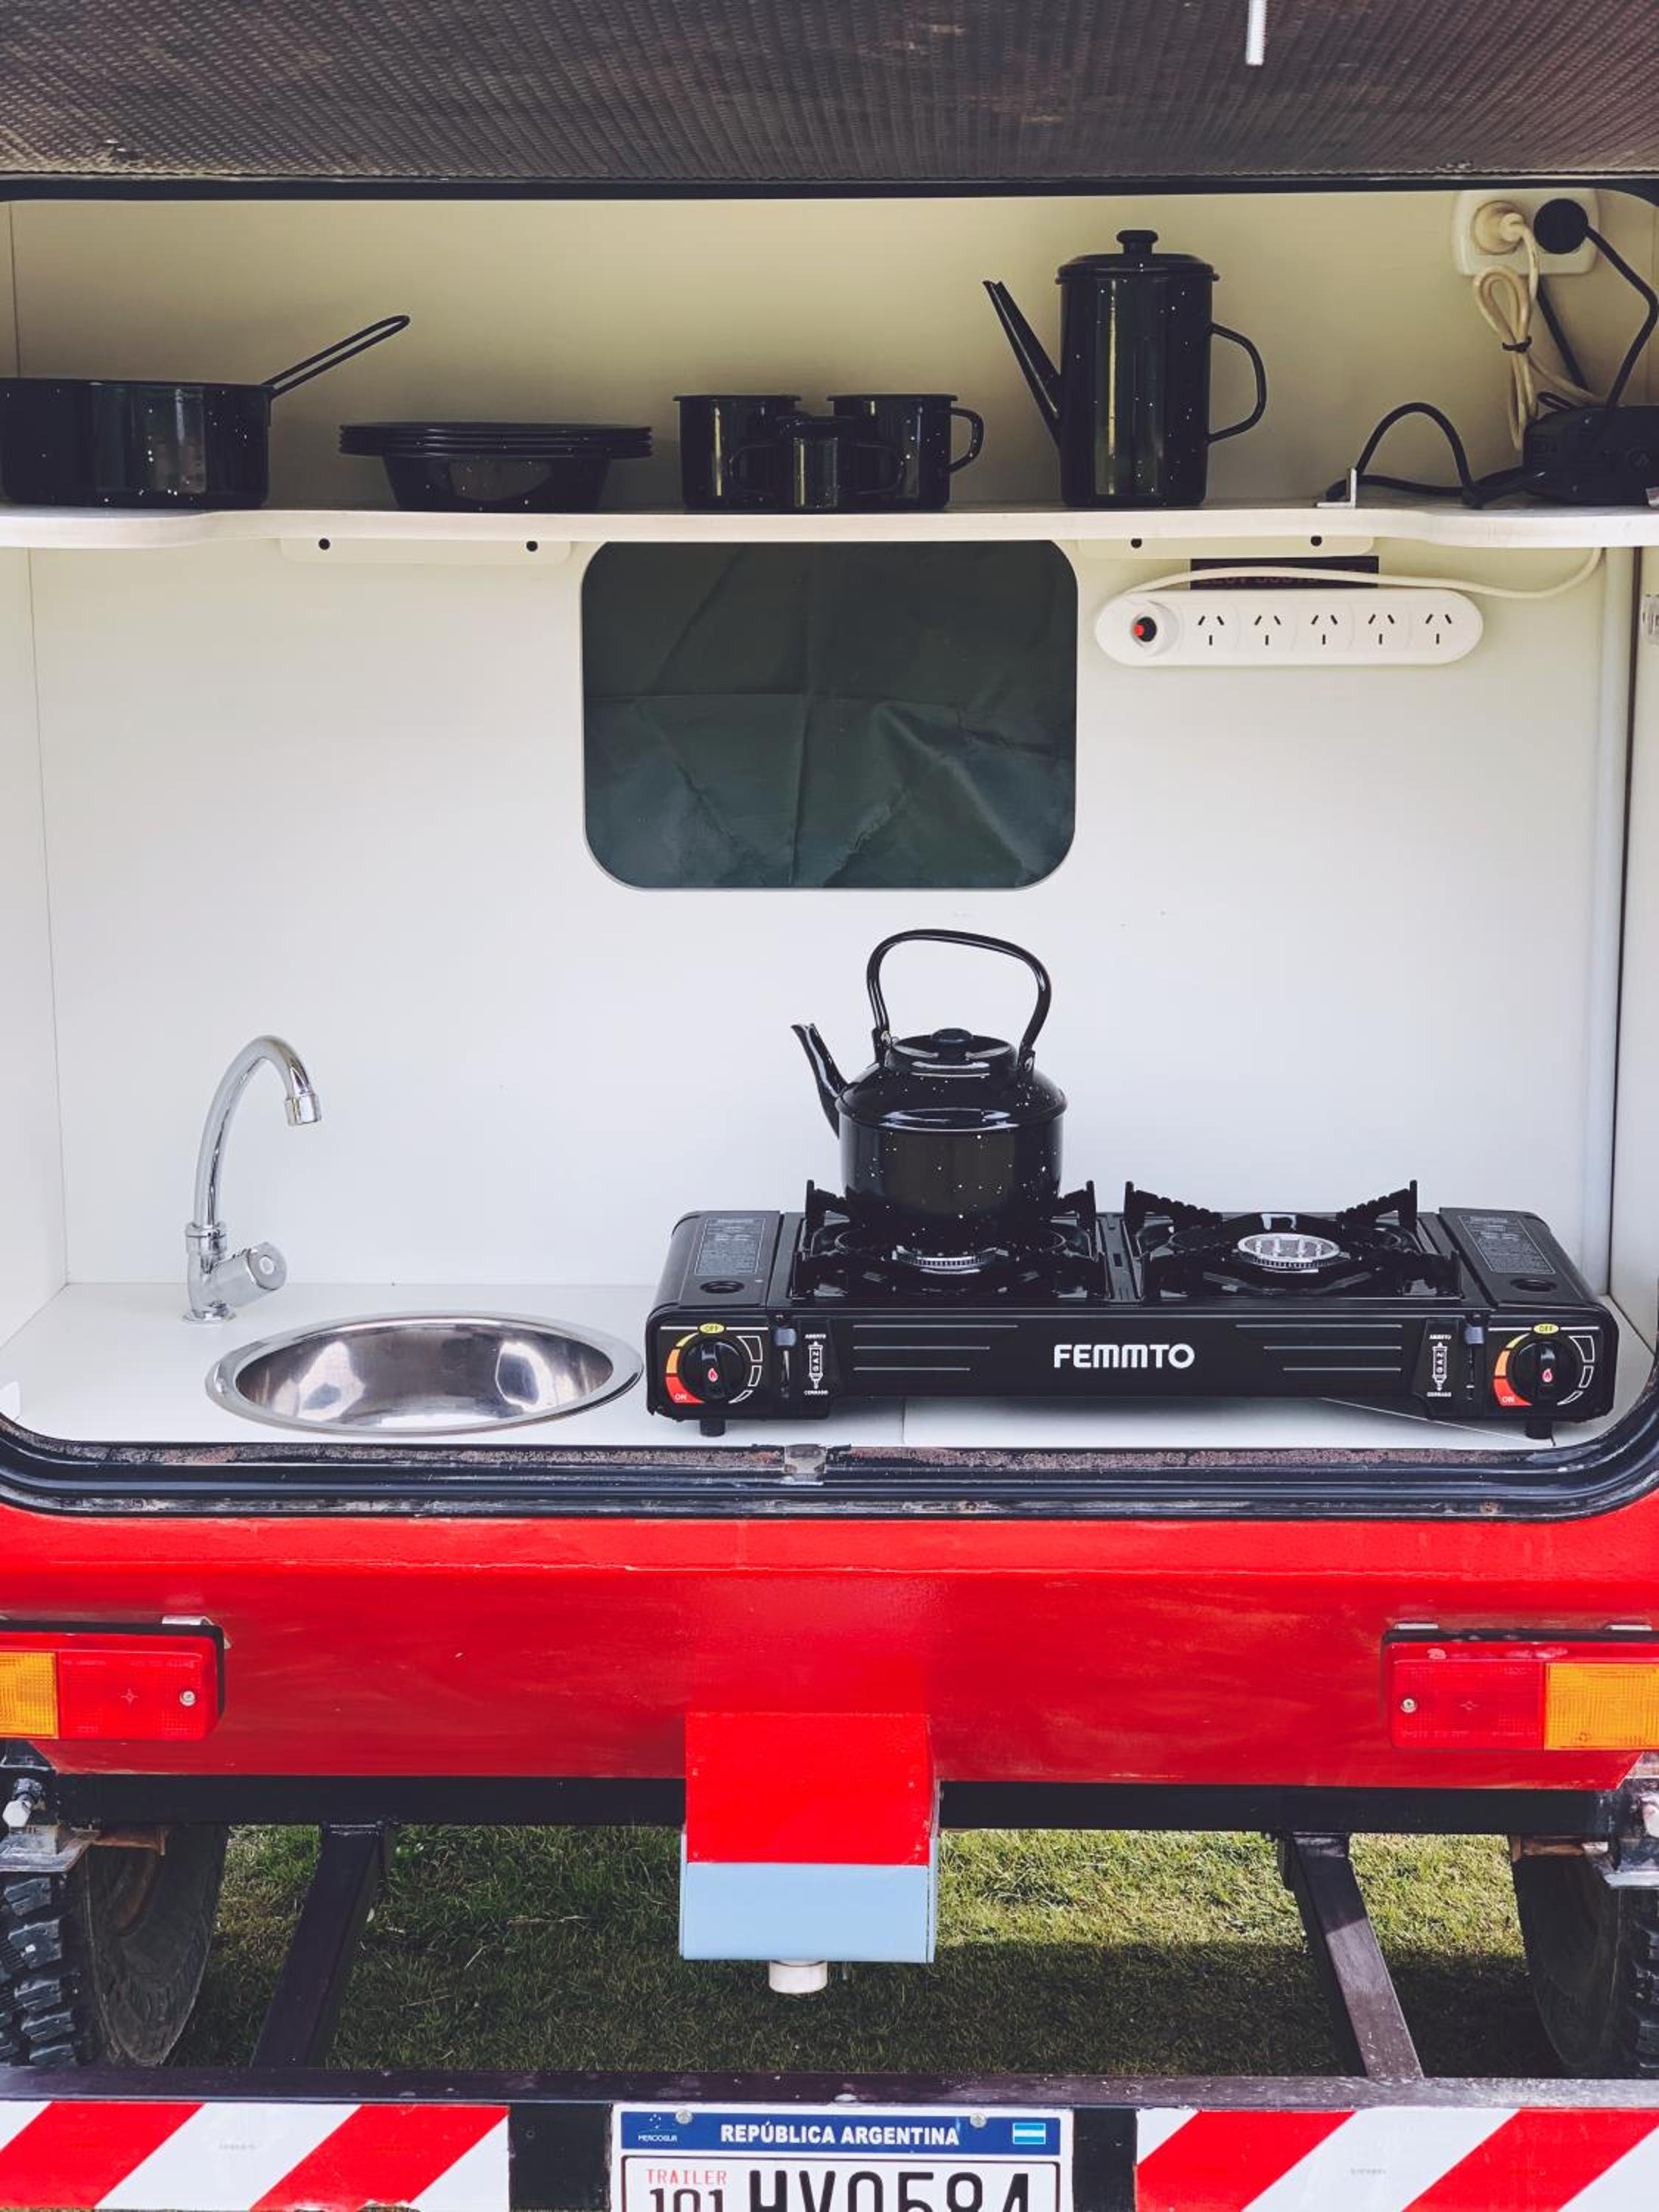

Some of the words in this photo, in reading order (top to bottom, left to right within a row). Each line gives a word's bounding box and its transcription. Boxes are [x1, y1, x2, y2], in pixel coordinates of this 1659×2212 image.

[1054, 1343, 1194, 1368] FEMMTO
[720, 2121, 835, 2143] REPÚBLICA
[841, 2126, 959, 2145] ARGENTINA
[646, 2169, 727, 2185] TRAILER
